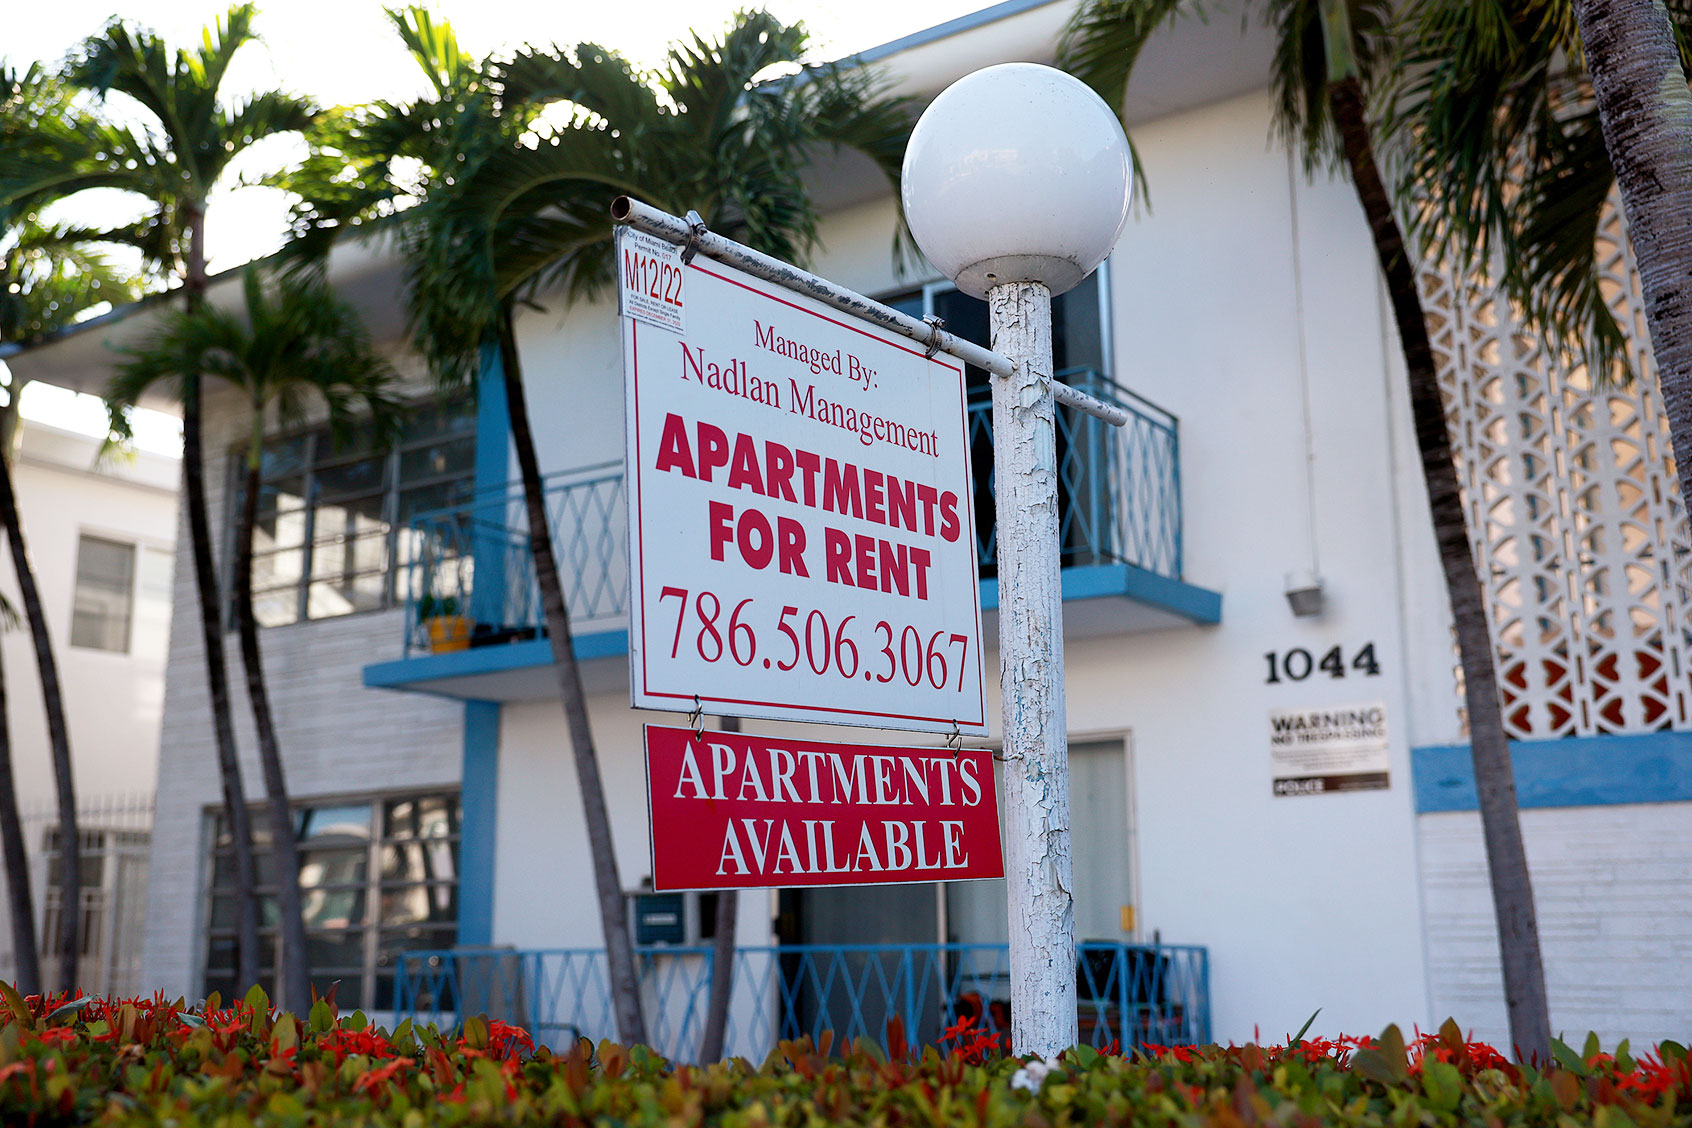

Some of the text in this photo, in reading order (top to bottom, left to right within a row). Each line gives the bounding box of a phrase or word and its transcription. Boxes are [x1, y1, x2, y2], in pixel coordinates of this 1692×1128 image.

[627, 231, 678, 254] City of Miami Beach
[634, 242, 652, 252] Permit
[652, 249, 662, 258] No.
[625, 248, 683, 307] M12/22
[754, 320, 879, 392] Managed By:
[679, 341, 940, 458] Nadlan Management
[655, 413, 960, 543] APARTMENTS
[708, 500, 931, 601] FOR RENT
[658, 586, 968, 693] 786.506.3067
[1265, 642, 1381, 684] 1044
[1271, 708, 1384, 731] WARNING
[1271, 734, 1293, 745] NO
[673, 740, 982, 807] APARTMENTS
[1275, 780, 1325, 796] POLICE
[715, 817, 969, 875] AVAILABLE
